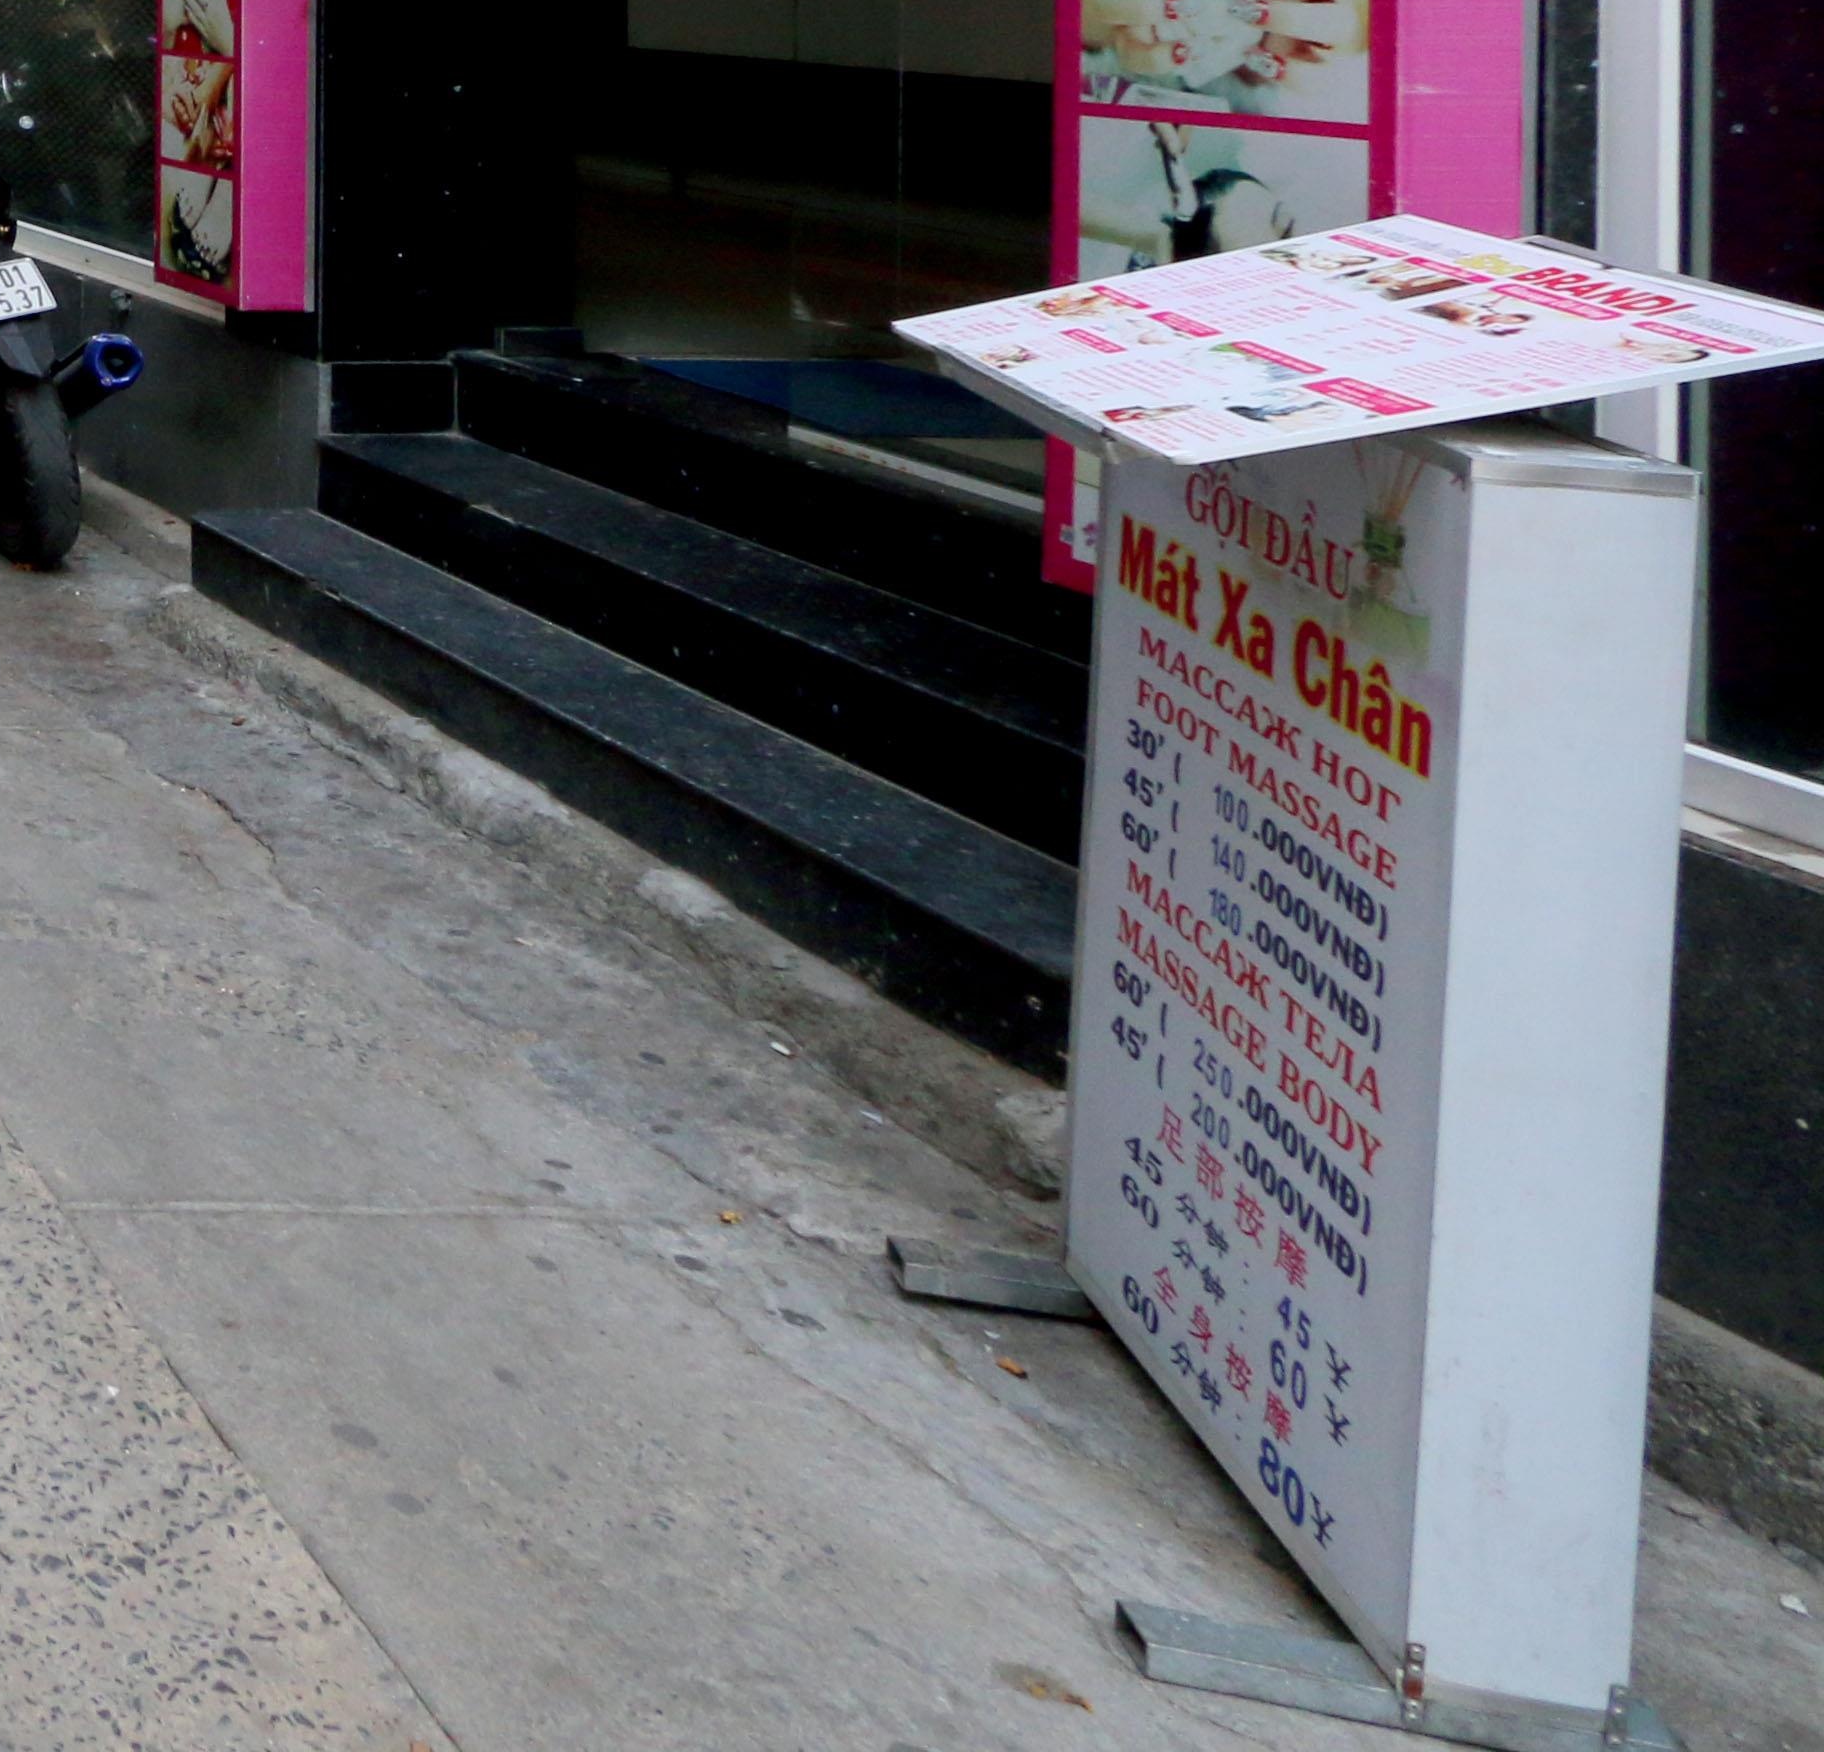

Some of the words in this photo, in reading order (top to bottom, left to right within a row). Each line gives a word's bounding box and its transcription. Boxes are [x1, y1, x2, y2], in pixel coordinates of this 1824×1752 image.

[1512, 267, 1699, 317] BRANDI
[1185, 470, 1253, 550] GỘI
[1263, 500, 1355, 600] ĐẦU
[1118, 513, 1200, 634] Mát
[1214, 568, 1275, 680] Xa
[1291, 617, 1432, 779] Chân
[1137, 677, 1220, 755] FOOT
[1227, 740, 1397, 890] MASSAGE
[1116, 905, 1268, 1074] MASSAGE
[1277, 1049, 1384, 1178] BODY
[1121, 1173, 1159, 1229] 60
[1269, 1339, 1308, 1410] 60
[1124, 1136, 1163, 1187] 45
[1276, 1295, 1312, 1351] 45
[1157, 1102, 1308, 1291] 足部按摩
[1122, 1274, 1159, 1335] 60
[1153, 1266, 1294, 1445] 全身按摩
